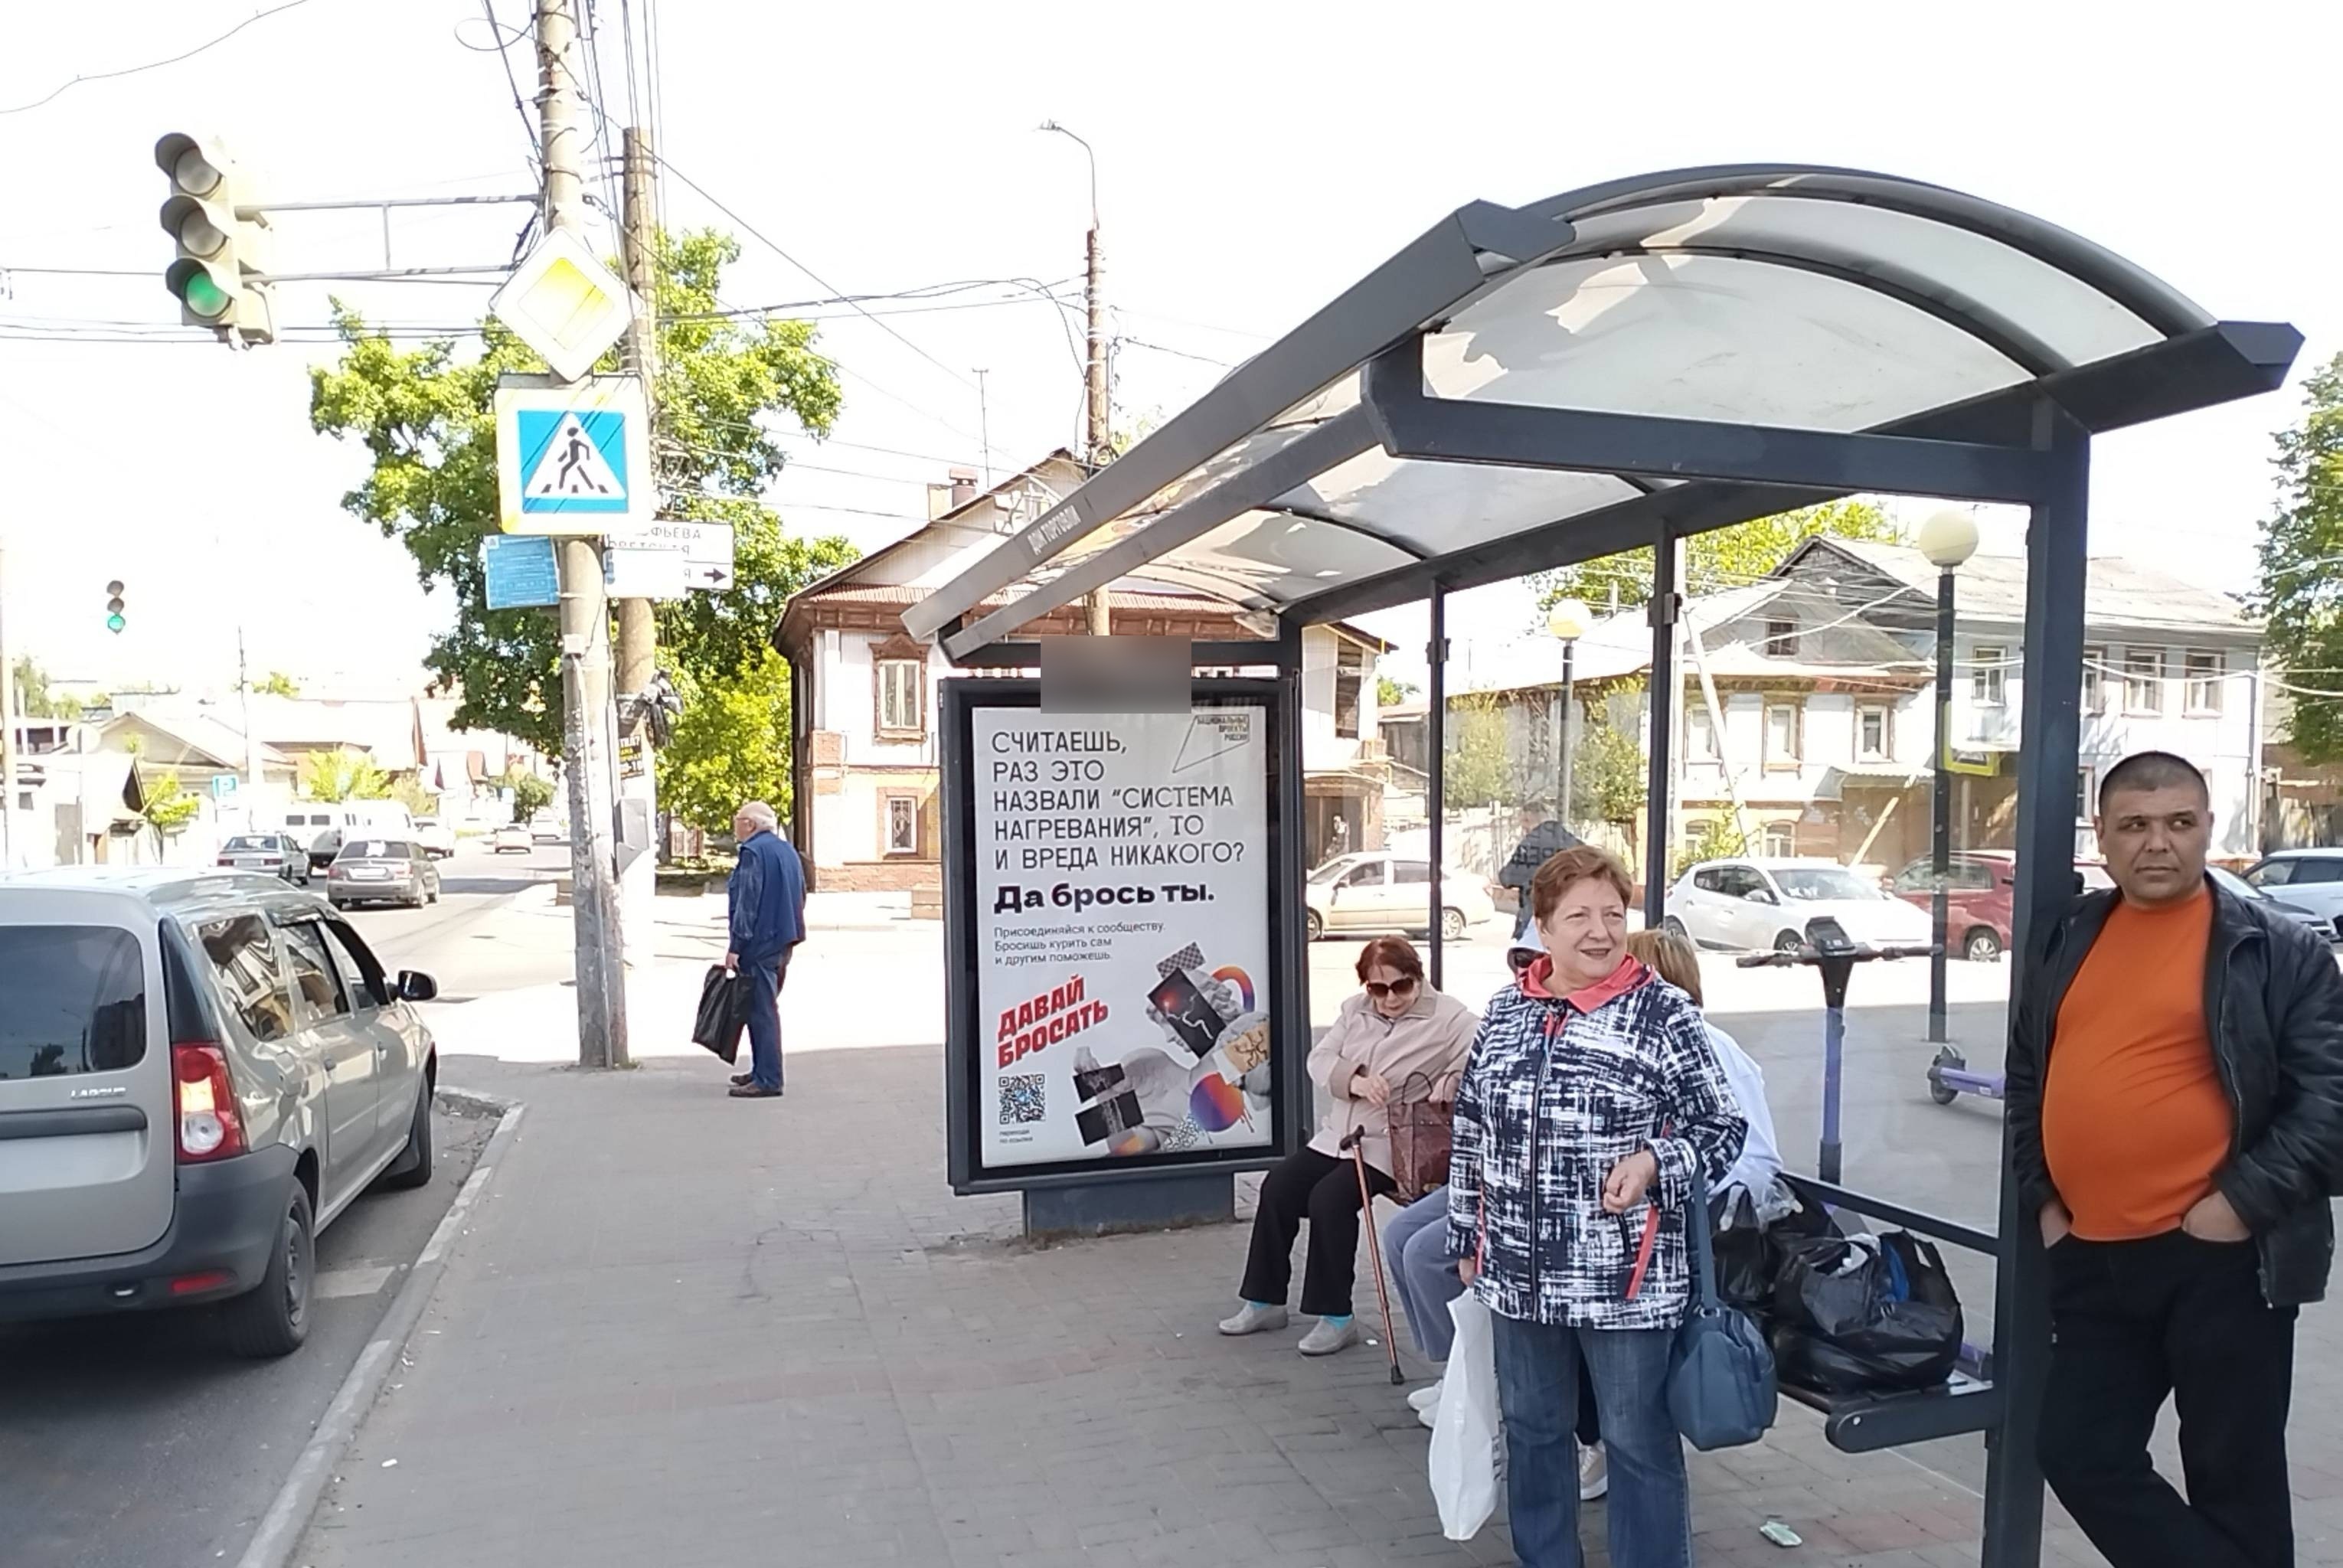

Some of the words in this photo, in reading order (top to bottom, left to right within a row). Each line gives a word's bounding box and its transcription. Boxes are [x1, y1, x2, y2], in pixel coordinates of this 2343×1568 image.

[636, 526, 702, 539] ФЬЕВА
[992, 732, 1127, 754] СЧИТАЕШЬ,
[994, 761, 1038, 782] РАЗ
[1051, 760, 1104, 782] ЭТО
[995, 790, 1100, 812] НАЗВАЛИ
[1170, 815, 1204, 836] ТО
[995, 850, 1008, 870] И
[1023, 846, 1098, 872] ВРЕДА
[1111, 842, 1244, 867] НИКАКОГО?
[994, 885, 1044, 914] Да
[1051, 883, 1155, 913] брось
[1161, 884, 1214, 902] ты.
[995, 926, 1084, 939] Присоединяйся
[1088, 925, 1095, 933] к
[1097, 922, 1165, 933] сообществу.
[995, 940, 1047, 952] Бросишь
[1049, 939, 1087, 950] курить
[1090, 938, 1113, 947] сам
[1005, 955, 1047, 967] другим
[998, 973, 1085, 1042] ДАВАЙ
[998, 999, 1109, 1070] БРОСАТЬ
